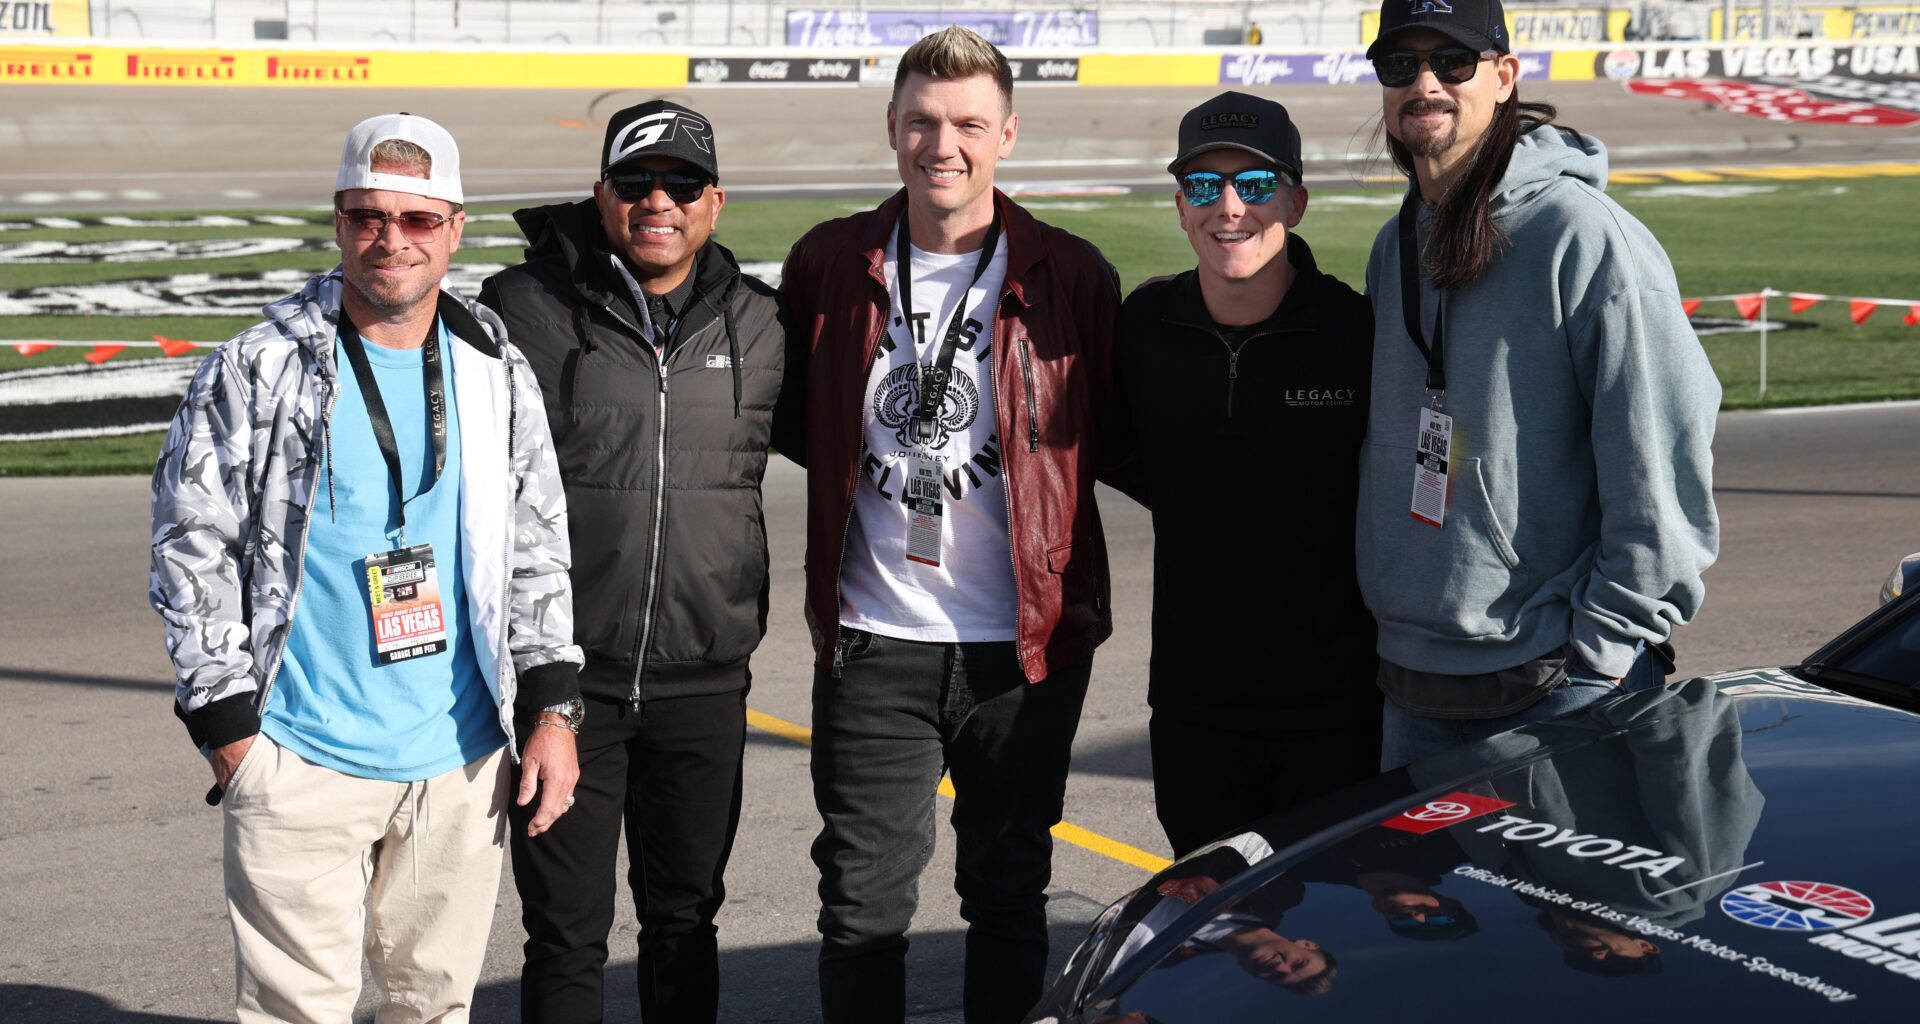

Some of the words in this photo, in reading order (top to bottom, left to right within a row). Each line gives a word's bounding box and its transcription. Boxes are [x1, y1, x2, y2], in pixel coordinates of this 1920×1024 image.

[1514, 15, 1603, 41] PENNZO
[127, 54, 235, 79] PIRELLI
[267, 56, 370, 80] PIRELLI
[1642, 48, 1710, 79] LAS
[1202, 113, 1259, 126] LEGACY
[609, 110, 714, 166] GR
[926, 366, 946, 414] LEGACY
[1285, 389, 1356, 401] LEGACY
[430, 389, 442, 437] LEGACY
[1420, 430, 1431, 451] LAS
[910, 478, 922, 496] LAS
[922, 480, 941, 500] VEGAS
[377, 615, 402, 639] LAS
[401, 608, 441, 635] VEGAS
[389, 649, 412, 661] GARAGE
[1476, 815, 1686, 878] TOYOTA
[1453, 864, 1516, 889] Official
[1511, 878, 1573, 905] Vehicle
[1571, 900, 1597, 914] of
[1590, 905, 1627, 923] Las
[1626, 915, 1685, 941] Vegas
[1681, 934, 1748, 962] Motor
[1742, 956, 1857, 1002] Speedway
[1807, 932, 1920, 980] MOTO
